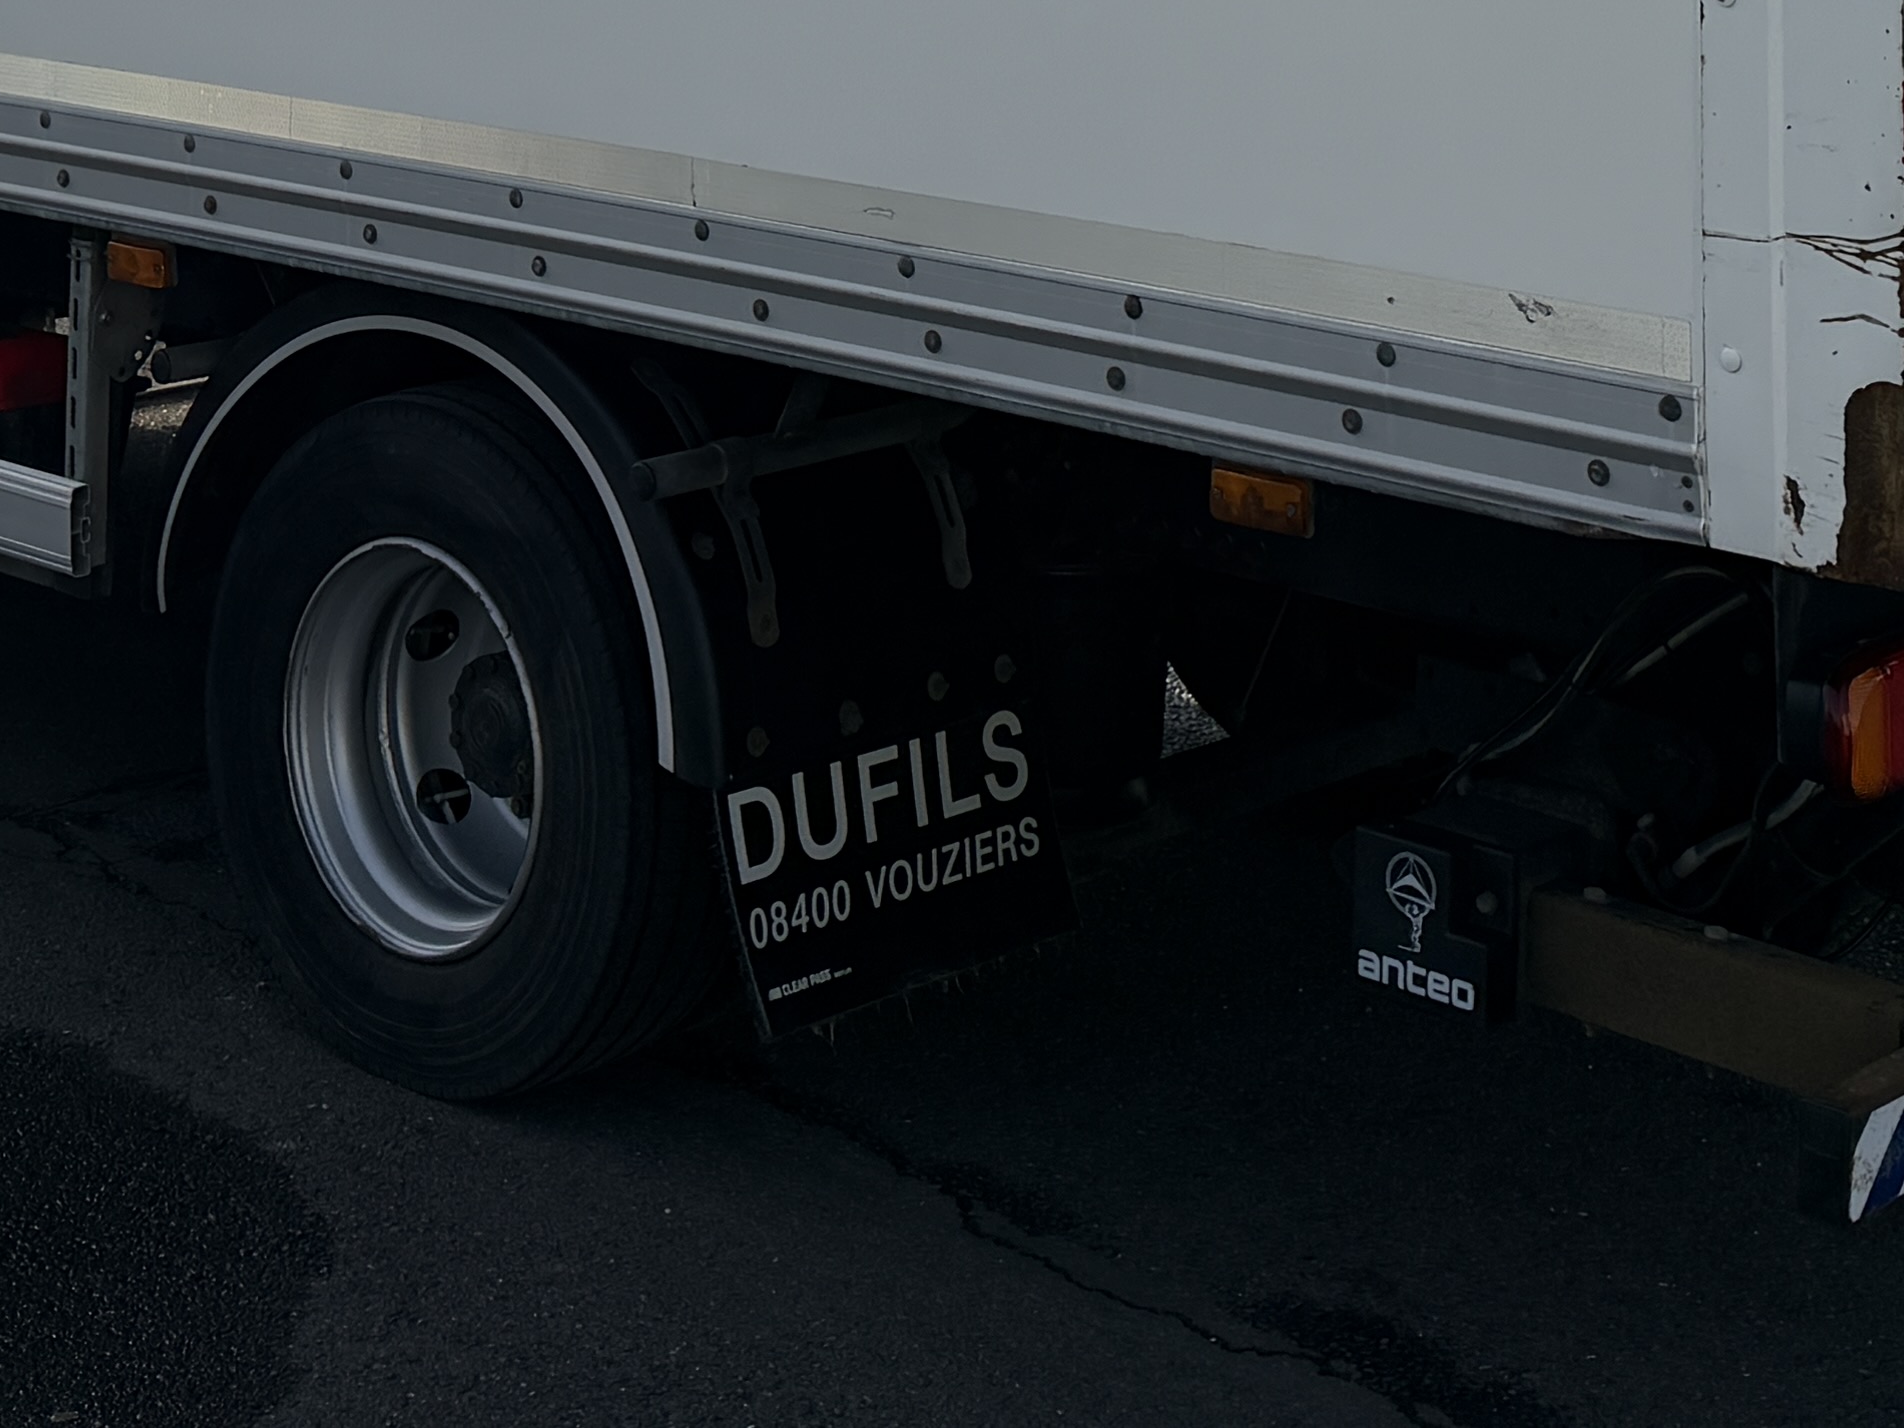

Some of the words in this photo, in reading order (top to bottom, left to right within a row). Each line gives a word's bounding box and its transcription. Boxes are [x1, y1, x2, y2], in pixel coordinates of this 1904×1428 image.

[727, 710, 1029, 885] DUFILS
[749, 880, 851, 949] 08400
[865, 816, 1040, 909] VOUZIERS
[1358, 948, 1475, 1011] anteo
